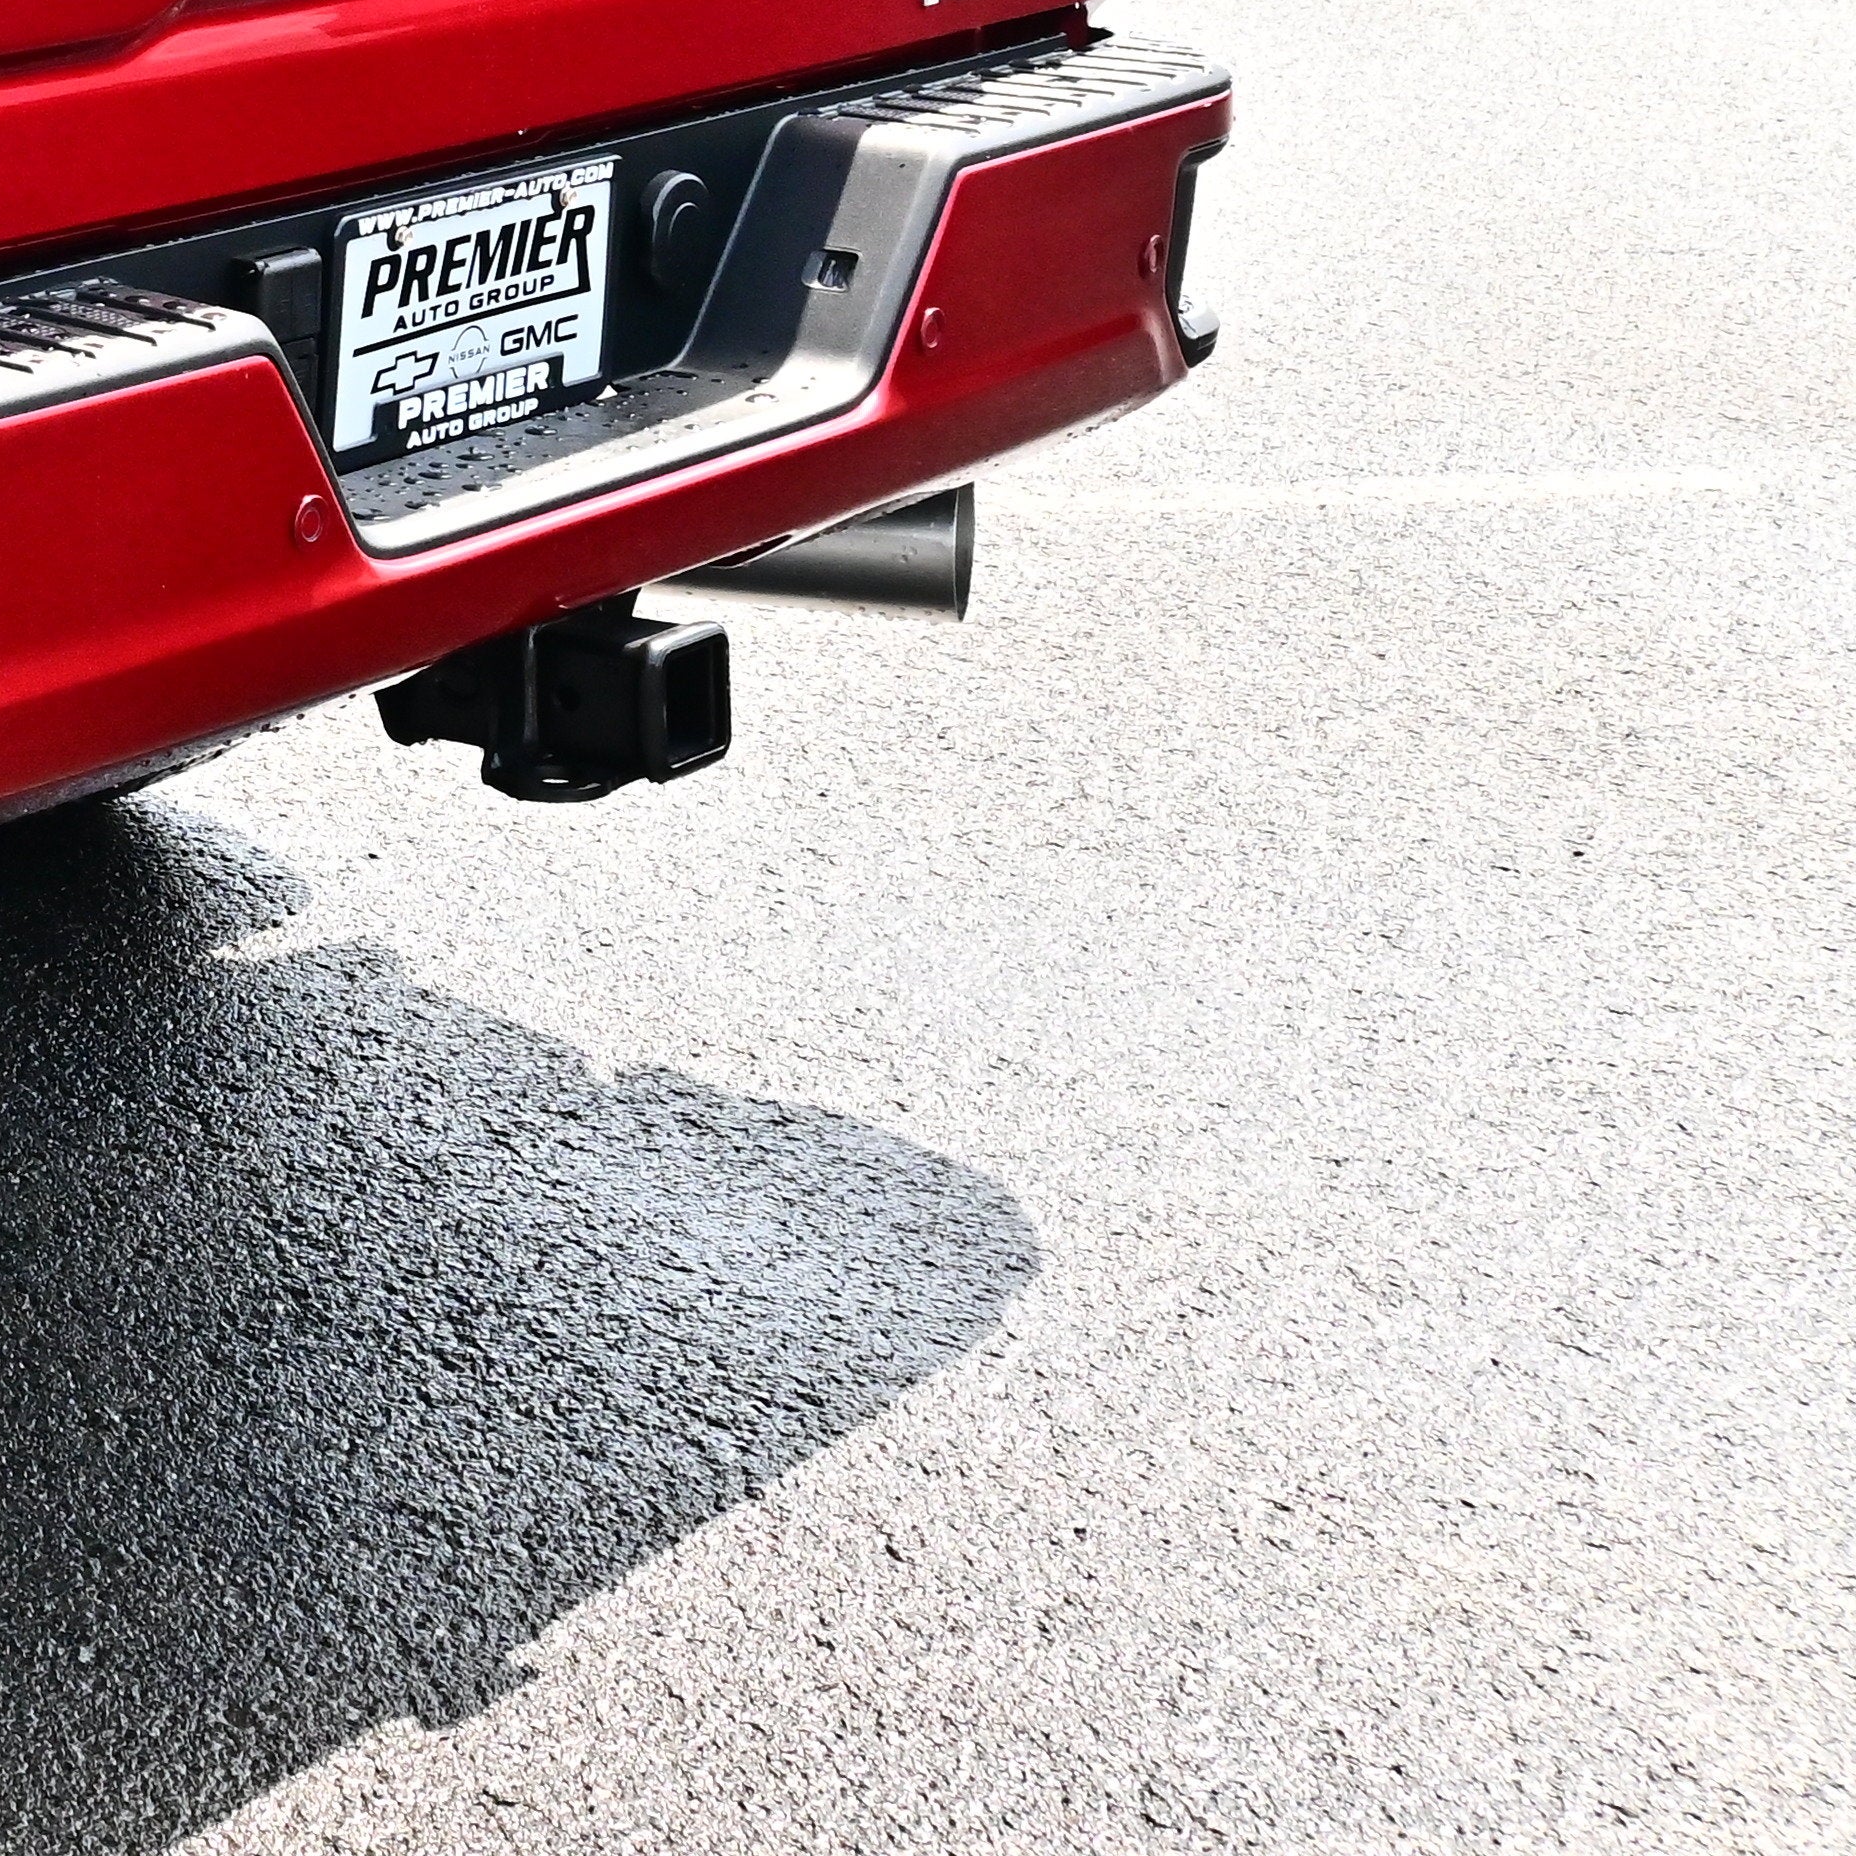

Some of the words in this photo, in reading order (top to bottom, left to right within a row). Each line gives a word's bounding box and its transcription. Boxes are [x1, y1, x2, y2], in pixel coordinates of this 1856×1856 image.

[358, 162, 615, 236] WWW.PREMIER-AUTO.COM
[360, 204, 596, 320] PREMIER
[393, 300, 459, 334] AUTO
[469, 274, 555, 311] GROUP
[448, 344, 491, 364] NISSAN
[500, 314, 579, 356] GMC
[397, 361, 551, 430] PREMIER
[406, 419, 464, 449] AUTO
[468, 397, 539, 431] GROUP
